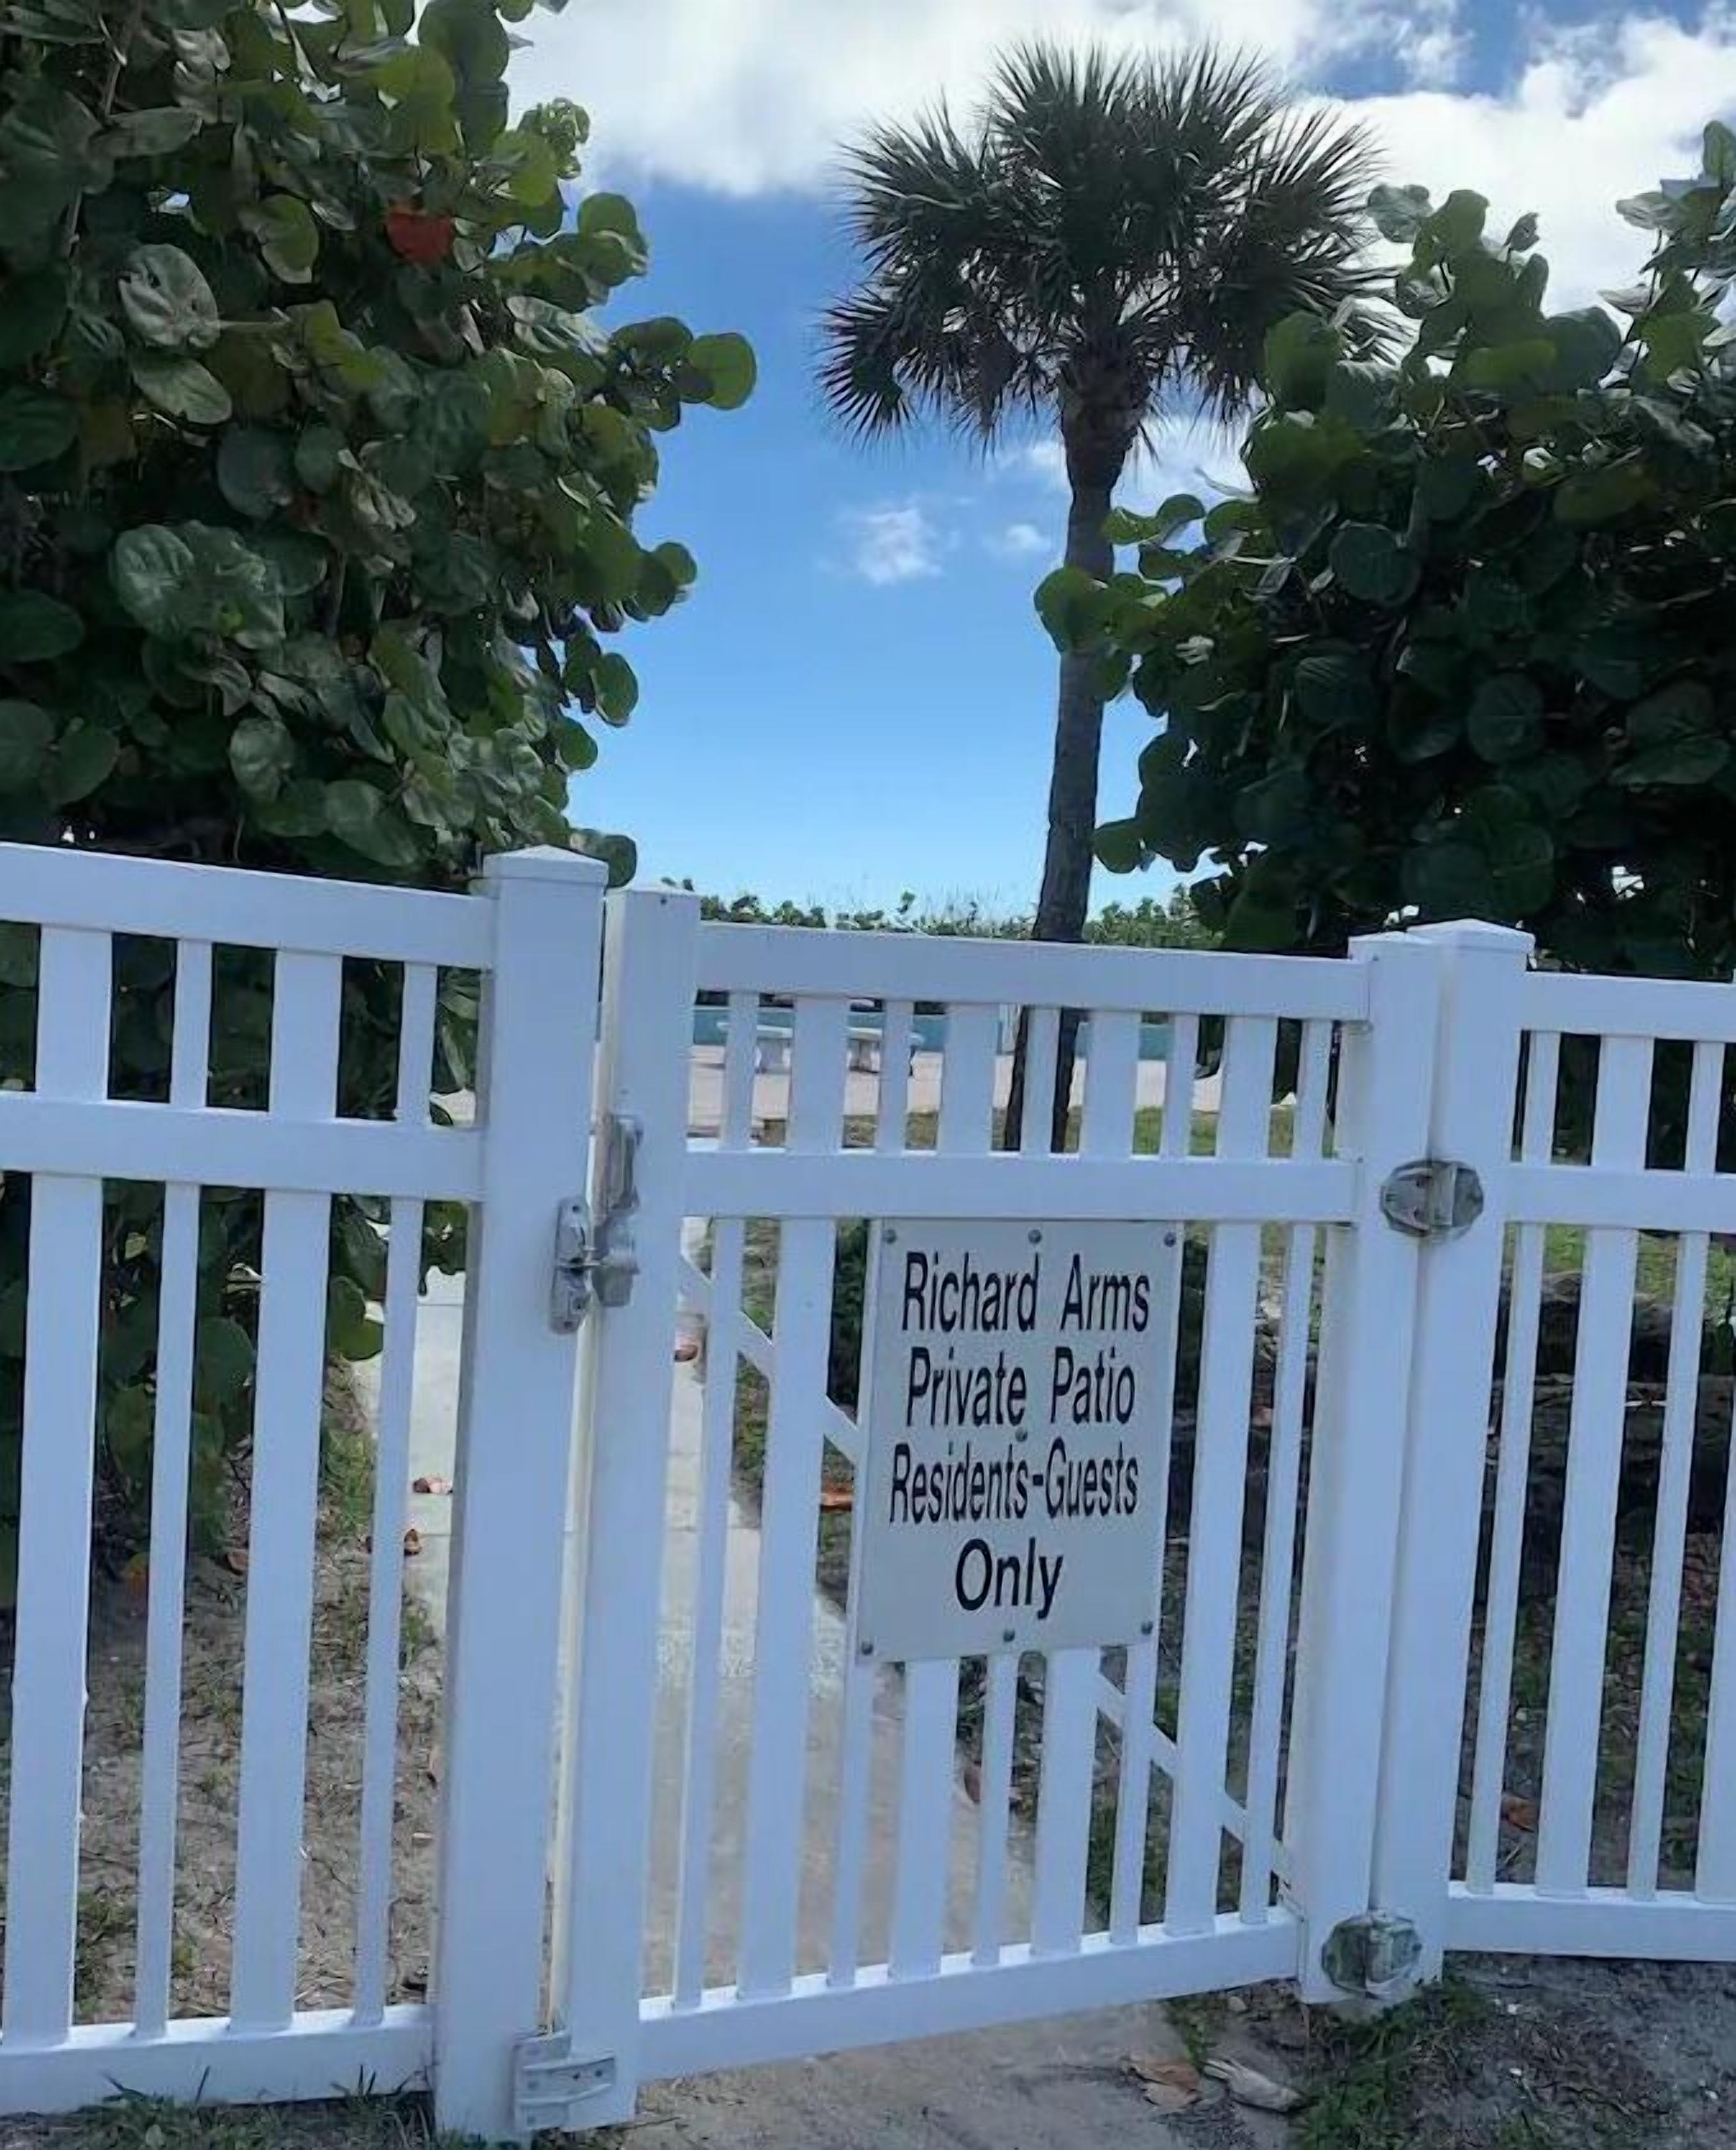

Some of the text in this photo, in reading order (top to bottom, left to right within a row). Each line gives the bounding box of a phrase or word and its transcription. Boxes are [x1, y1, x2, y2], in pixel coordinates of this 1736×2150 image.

[902, 1251, 1151, 1333] Richard Arms
[906, 1345, 1135, 1427] Private Patio
[889, 1436, 1138, 1525] Residents-Guests
[955, 1536, 1064, 1621] Only
